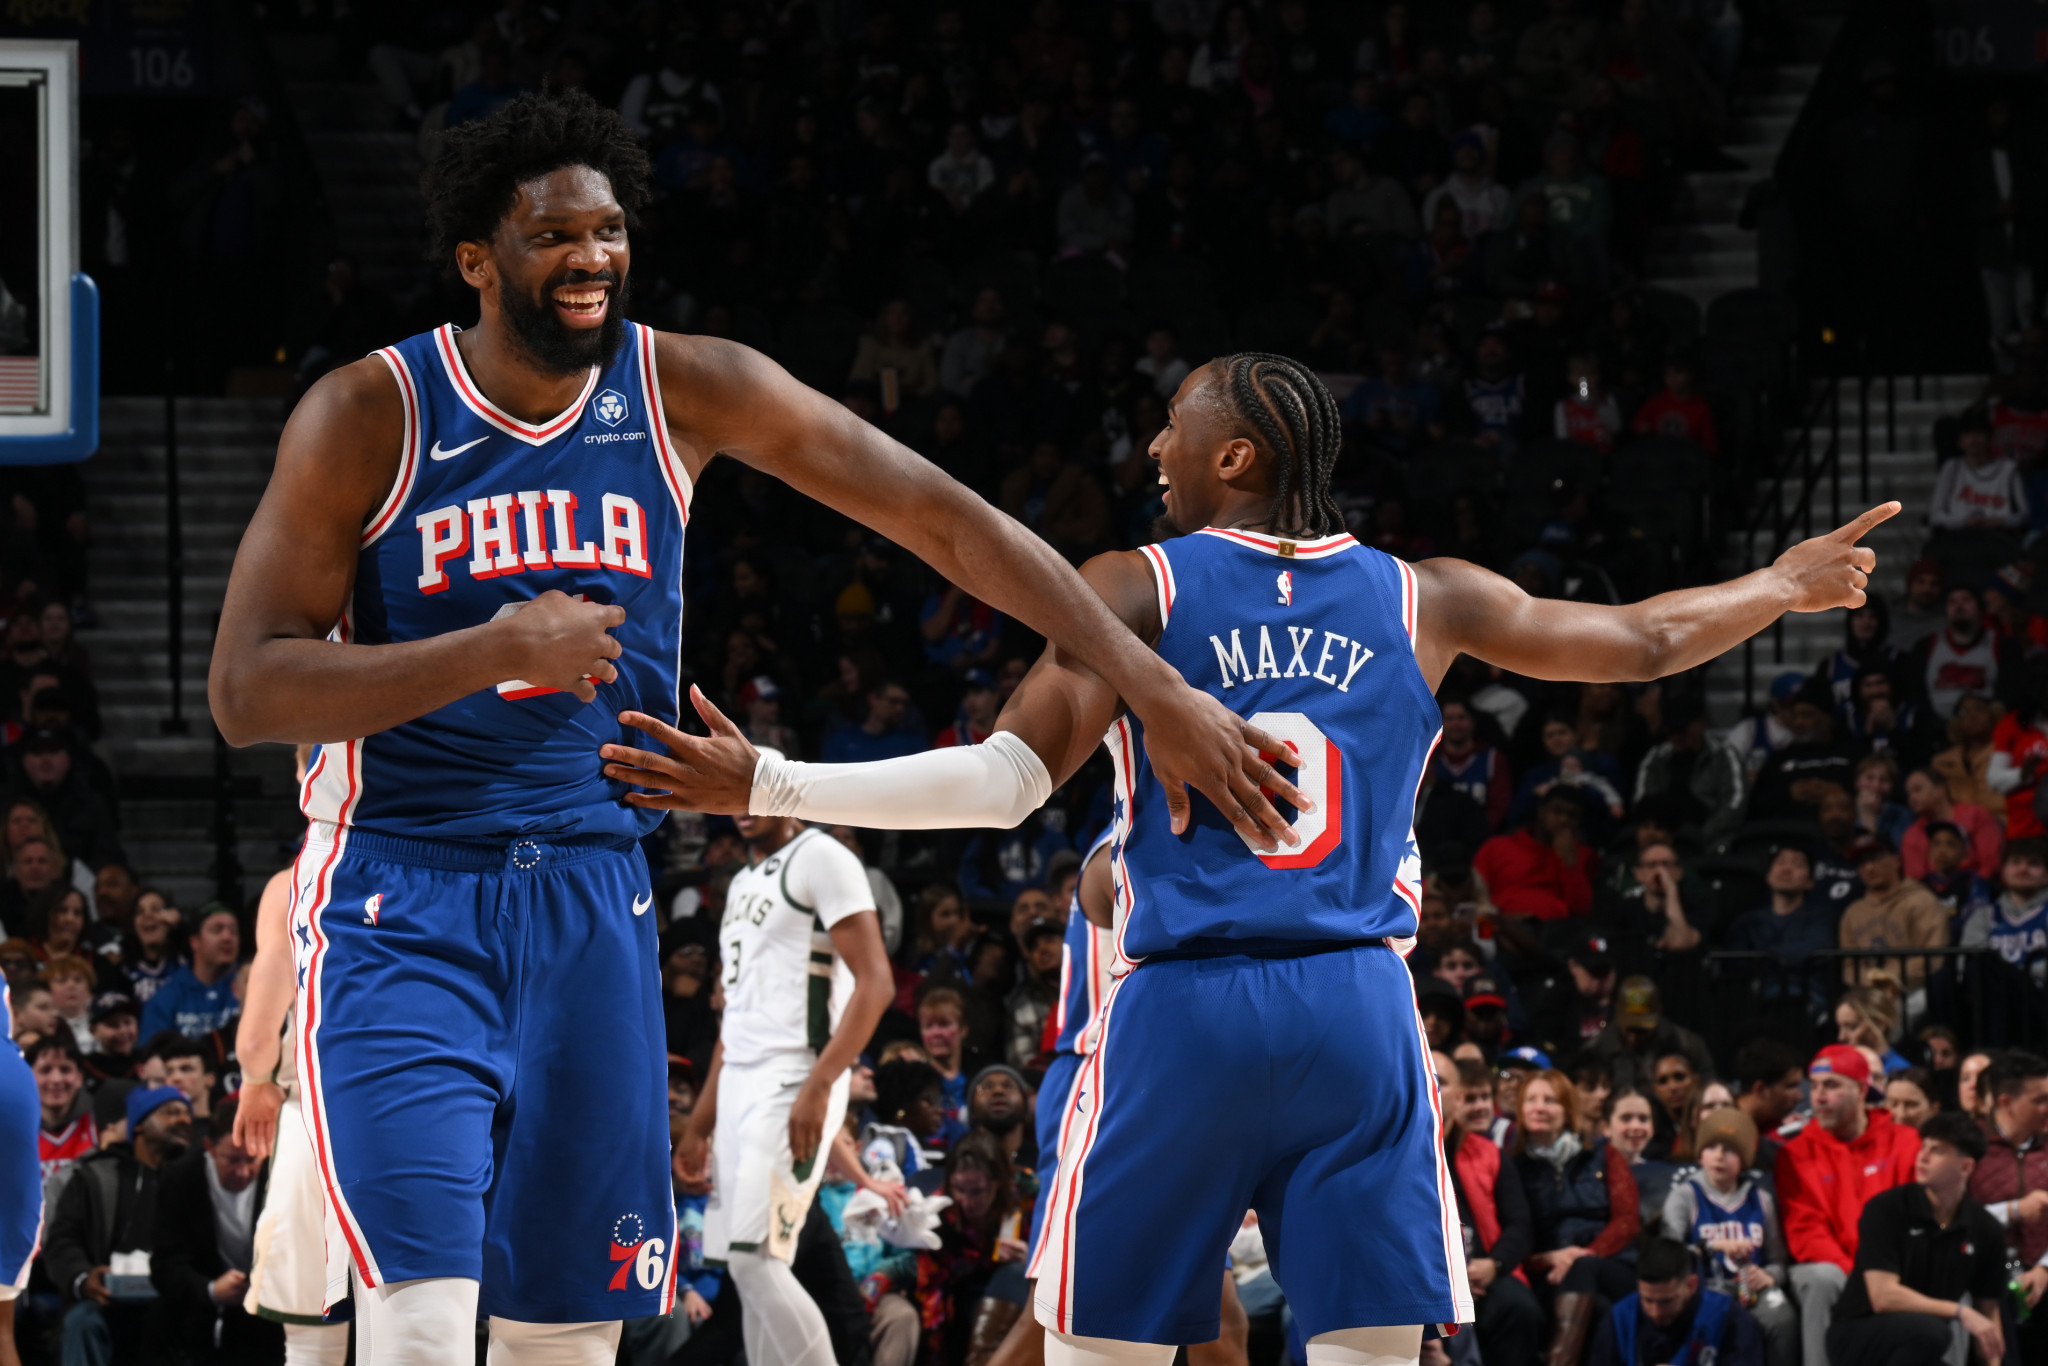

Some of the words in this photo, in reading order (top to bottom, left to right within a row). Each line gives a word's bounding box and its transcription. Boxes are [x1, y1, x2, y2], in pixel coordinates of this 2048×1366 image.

[128, 47, 196, 89] 106
[584, 431, 647, 445] crypto.com
[415, 489, 652, 596] PHILA
[1209, 625, 1374, 693] MAXEY
[727, 940, 742, 985] 3
[608, 1238, 665, 1292] 76
